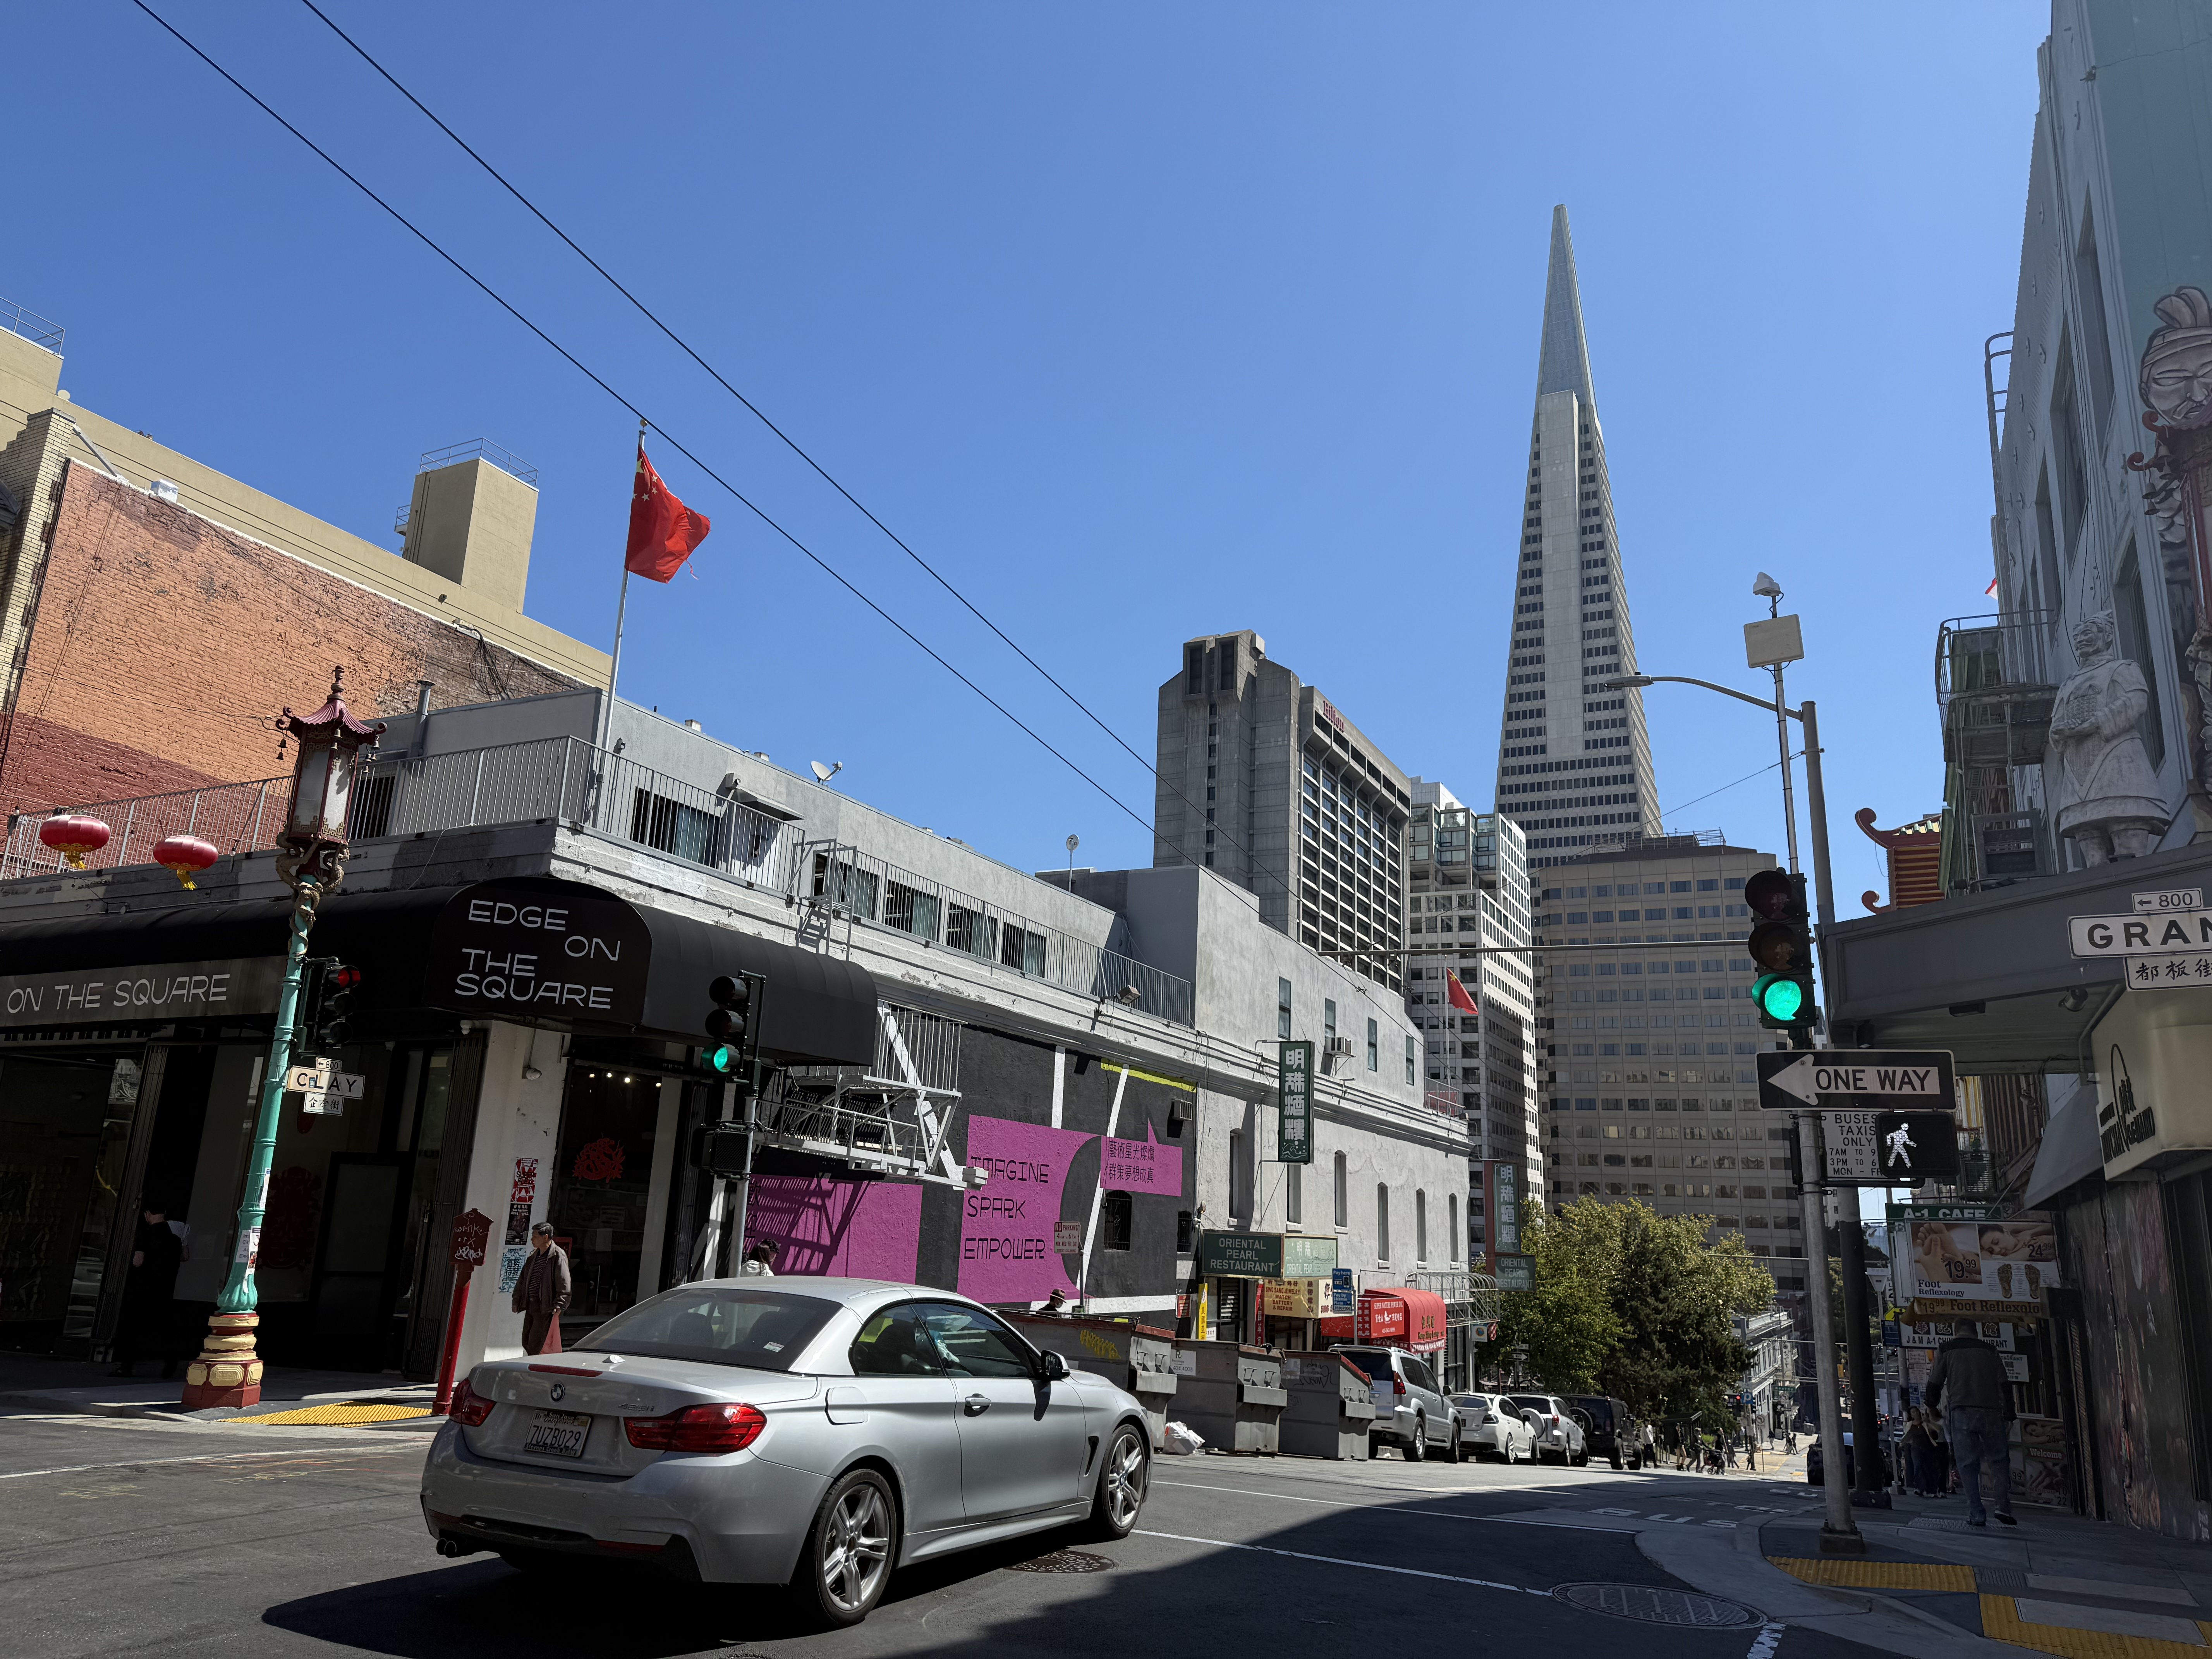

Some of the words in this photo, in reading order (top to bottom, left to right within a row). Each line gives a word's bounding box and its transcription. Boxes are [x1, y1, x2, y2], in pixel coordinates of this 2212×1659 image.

[1323, 700, 1344, 733] Hilton
[2159, 893, 2193, 907] 800
[468, 899, 569, 931] EDGE
[565, 935, 621, 962] ON
[462, 948, 538, 977] THE
[7, 986, 44, 1013] ON
[55, 982, 104, 1010] THE
[113, 974, 230, 1006] SQUARE
[455, 973, 614, 1009] SQUARE
[326, 1061, 338, 1070] 800
[297, 1072, 357, 1093] CLAY
[1815, 1068, 1868, 1091] ONE
[1876, 1069, 1931, 1091] WAY
[1284, 1048, 1305, 1140] 明珠酒樓
[1835, 1114, 1877, 1124] BUSES
[1838, 1125, 1876, 1136] TAXIS
[1843, 1137, 1873, 1146] ONLY
[1109, 1140, 1154, 1162] 藝術星光燦爛
[1109, 1163, 1154, 1184] 群策夢想成真
[1833, 1167, 1853, 1175] MON
[967, 1195, 1026, 1219] SPARK
[1500, 1165, 1516, 1243] 明珠酒樓
[1903, 1208, 1929, 1219] A-1
[1938, 1209, 1986, 1219] CAFE
[1055, 1223, 1062, 1231] NO
[964, 1238, 1045, 1259] EMPOWER
[1219, 1238, 1266, 1249] ORIENTAL
[1226, 1249, 1259, 1260] PEARL
[1210, 1259, 1274, 1273] RESTAURANT
[1287, 1264, 1302, 1274] ORIENTAL
[1501, 1258, 1528, 1267] ORIENTAL
[1505, 1268, 1524, 1278] PEARL
[1497, 1278, 1533, 1289] RESTAURANT
[1917, 1279, 1941, 1288] Foot
[1918, 1288, 1965, 1297] Reflexology
[1950, 1299, 1977, 1311] Foot
[1980, 1301, 2040, 1314] Reflexolo
[1918, 1336, 1923, 1344] M
[1927, 1336, 1936, 1345] A-1
[530, 1425, 581, 1449] 7UZB029
[2029, 1448, 2062, 1459] Welcome
